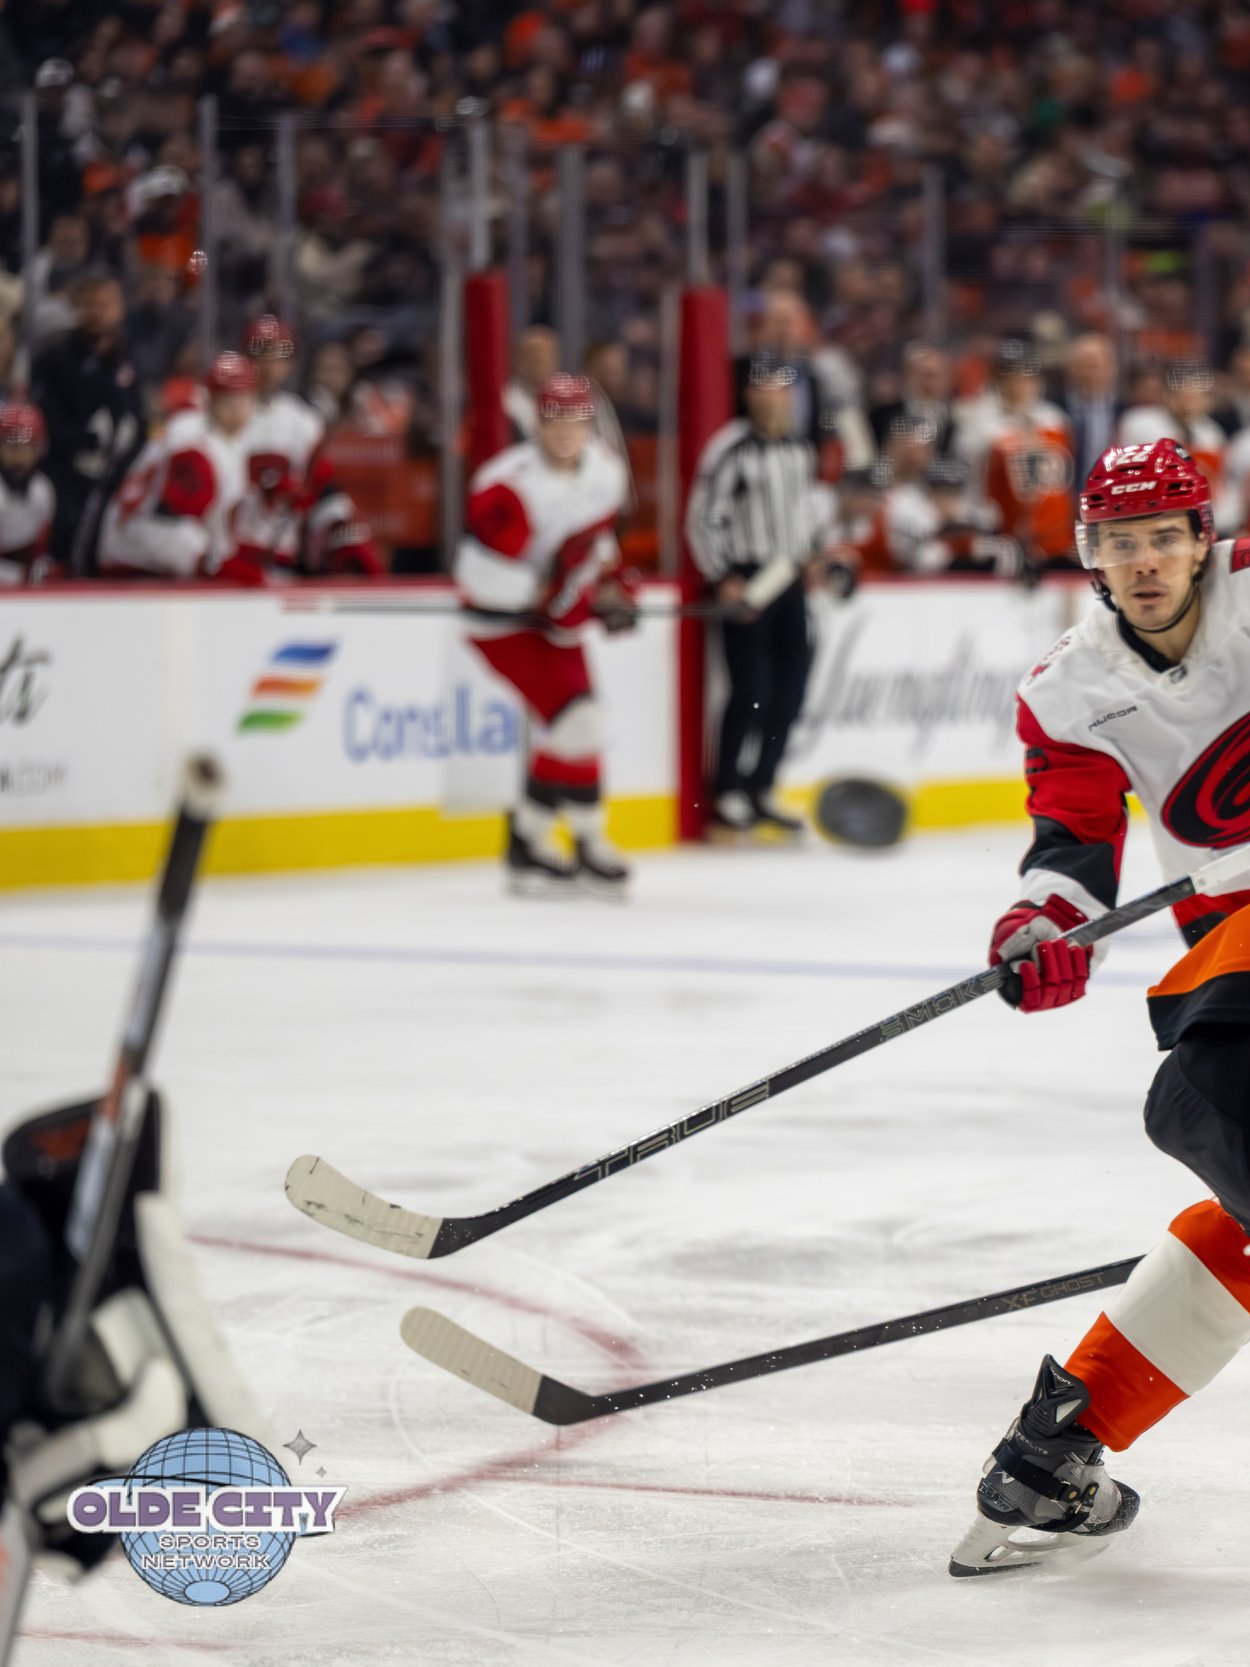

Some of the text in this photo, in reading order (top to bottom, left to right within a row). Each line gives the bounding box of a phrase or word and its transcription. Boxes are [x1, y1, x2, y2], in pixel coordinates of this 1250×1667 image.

[1110, 480, 1158, 496] CCM
[1088, 705, 1138, 732] NUCOR
[573, 1079, 769, 1182] TRUE
[1000, 1272, 1105, 1311] XF GHOST
